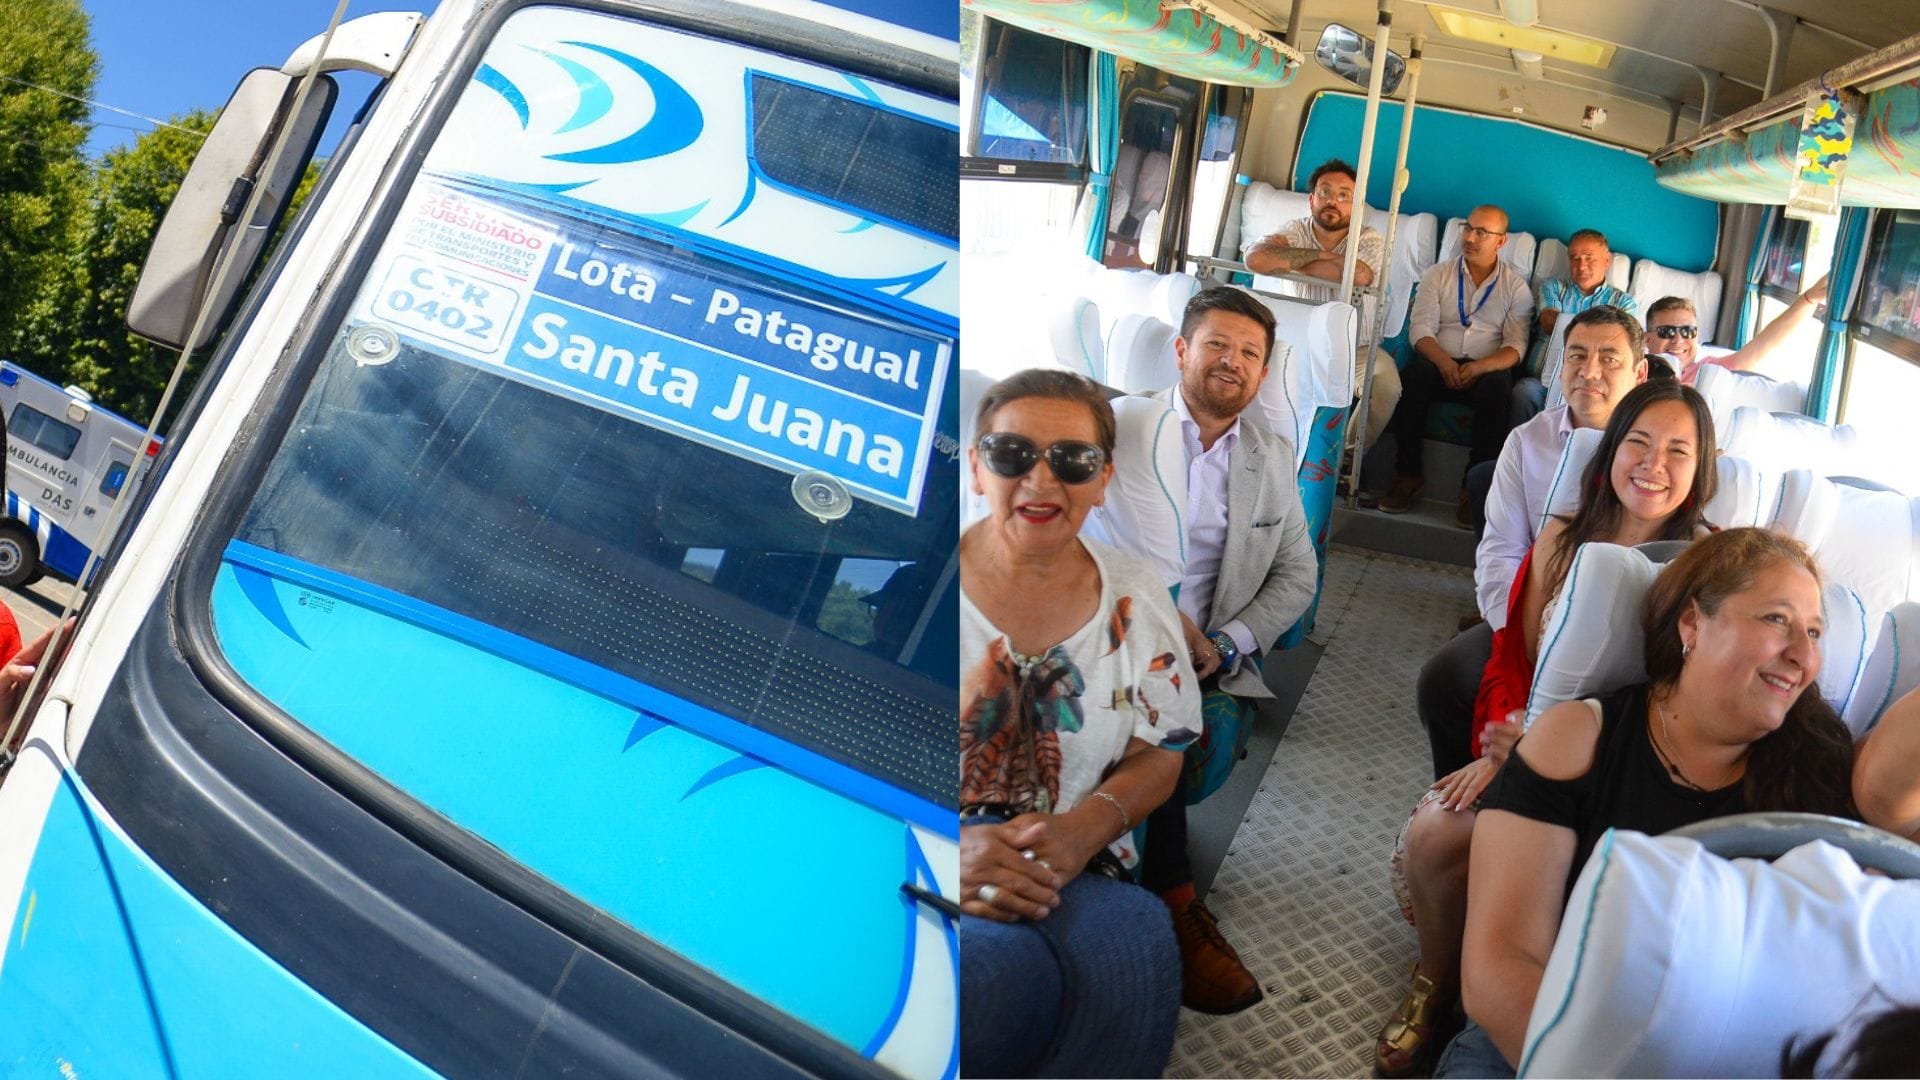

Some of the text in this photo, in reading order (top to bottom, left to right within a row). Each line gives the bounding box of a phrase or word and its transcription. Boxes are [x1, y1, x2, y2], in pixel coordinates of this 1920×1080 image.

[418, 203, 542, 250] SUBSIDIADO
[440, 224, 458, 237] EL
[459, 231, 537, 262] MINISTERIO
[429, 231, 520, 265] TRANSPORTES
[410, 267, 490, 308] CTR
[387, 289, 494, 340] 0402
[553, 243, 657, 304] Lota
[705, 288, 921, 390] Patagual
[522, 312, 904, 479] Santa Juana
[7, 445, 78, 487] MBULANCIA
[41, 488, 72, 510] DAS
